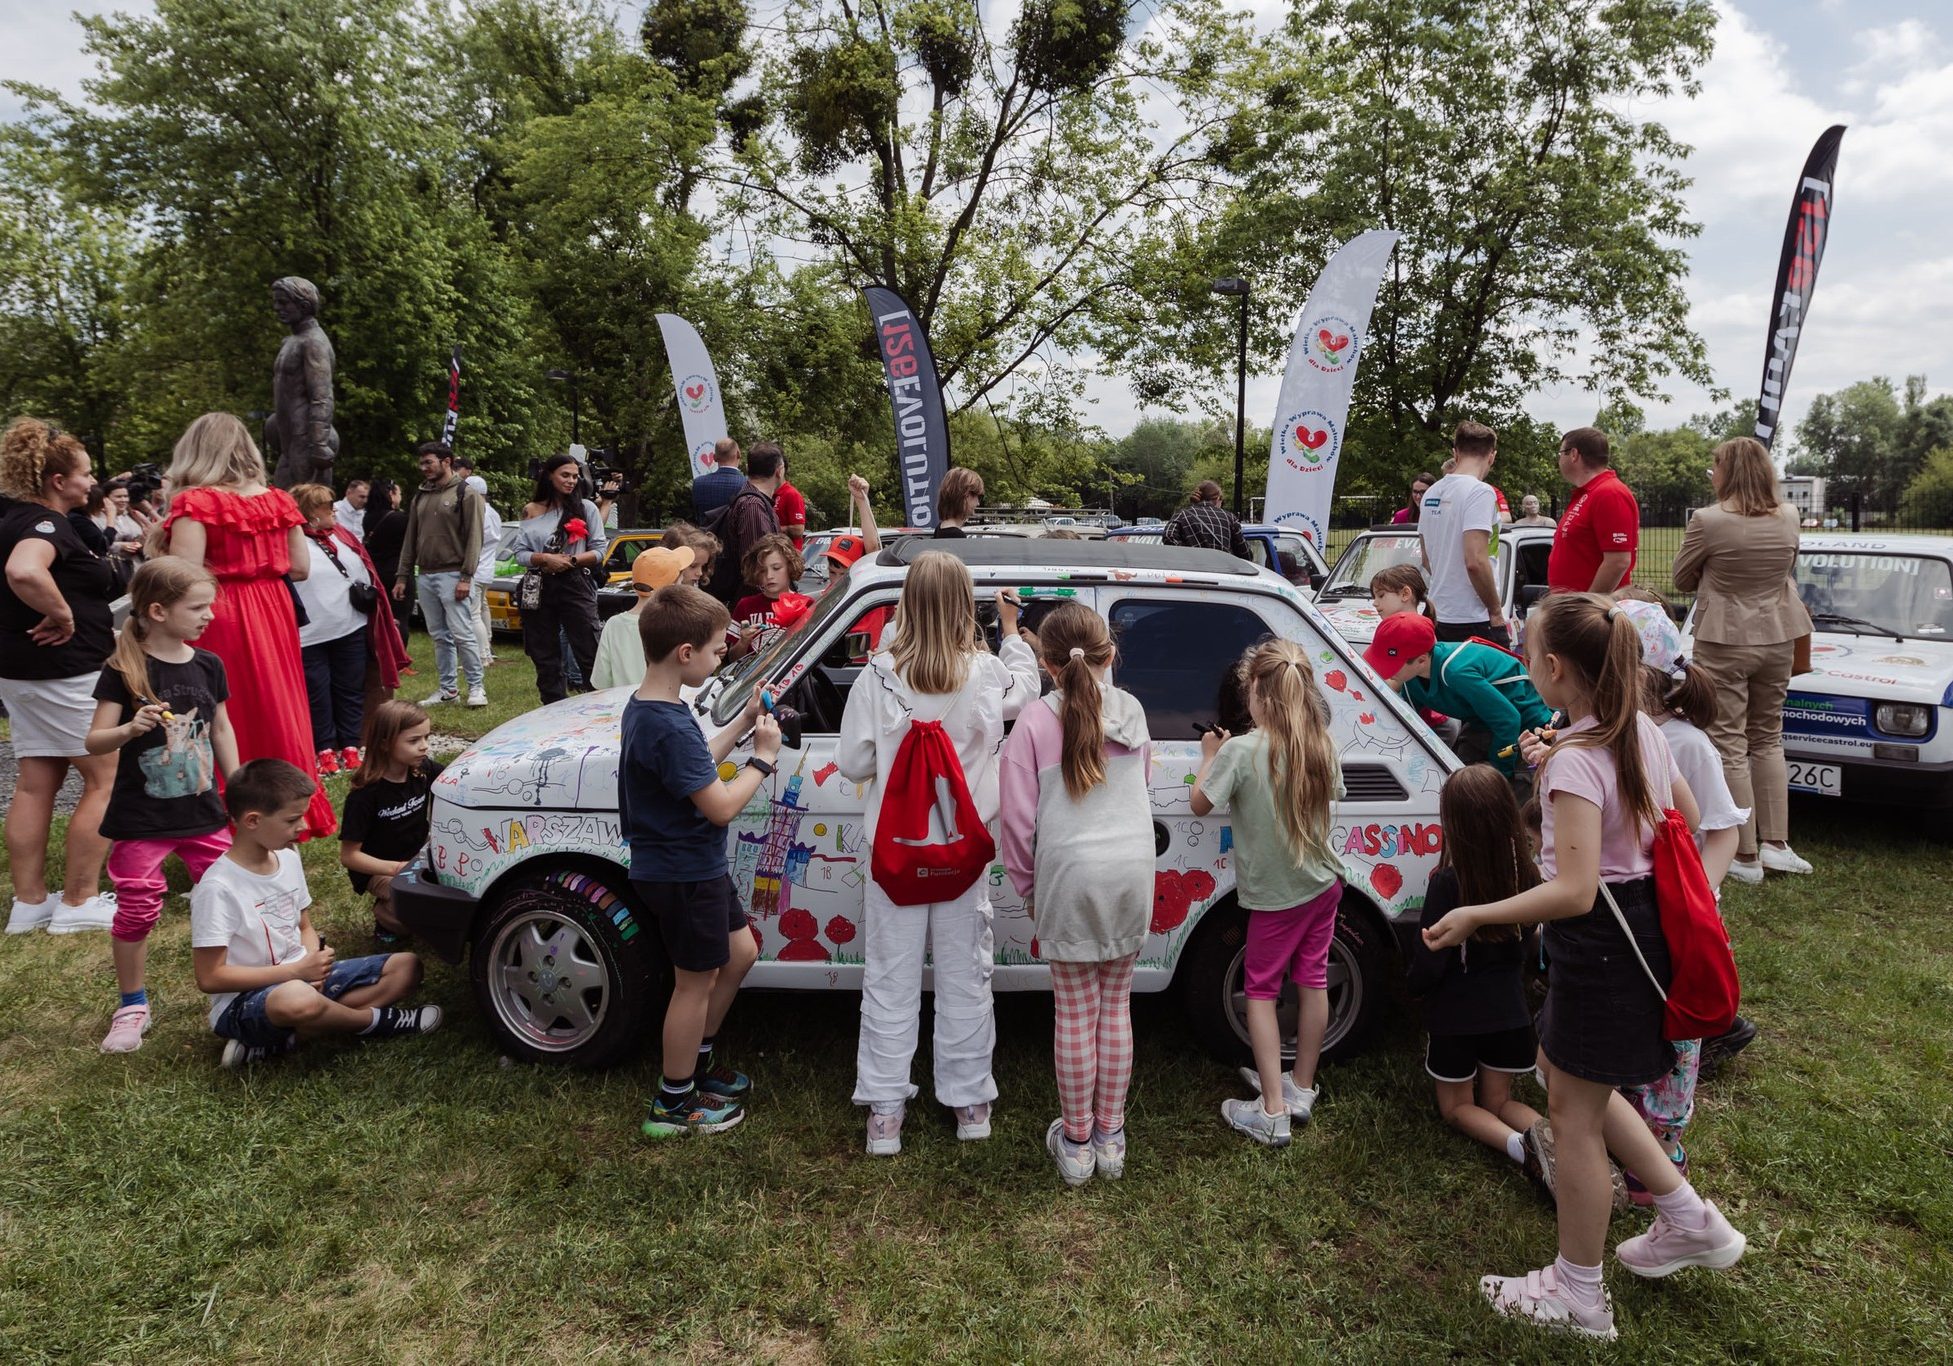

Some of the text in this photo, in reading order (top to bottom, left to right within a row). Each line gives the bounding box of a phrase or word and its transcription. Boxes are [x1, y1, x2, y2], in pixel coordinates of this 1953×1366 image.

[1313, 315, 1349, 327] Wyprawa
[1308, 358, 1344, 373] dla Dzieci
[1281, 423, 1290, 454] Wielka
[1289, 410, 1327, 423] Wyprawa
[1286, 458, 1324, 473] dla Dzieci
[1273, 511, 1311, 524] Wyprawa
[1827, 669, 1898, 685] Castrol
[1789, 764, 1834, 788] 26C
[1328, 823, 1442, 858] CASSINO
[1213, 858, 1227, 870] 1C
